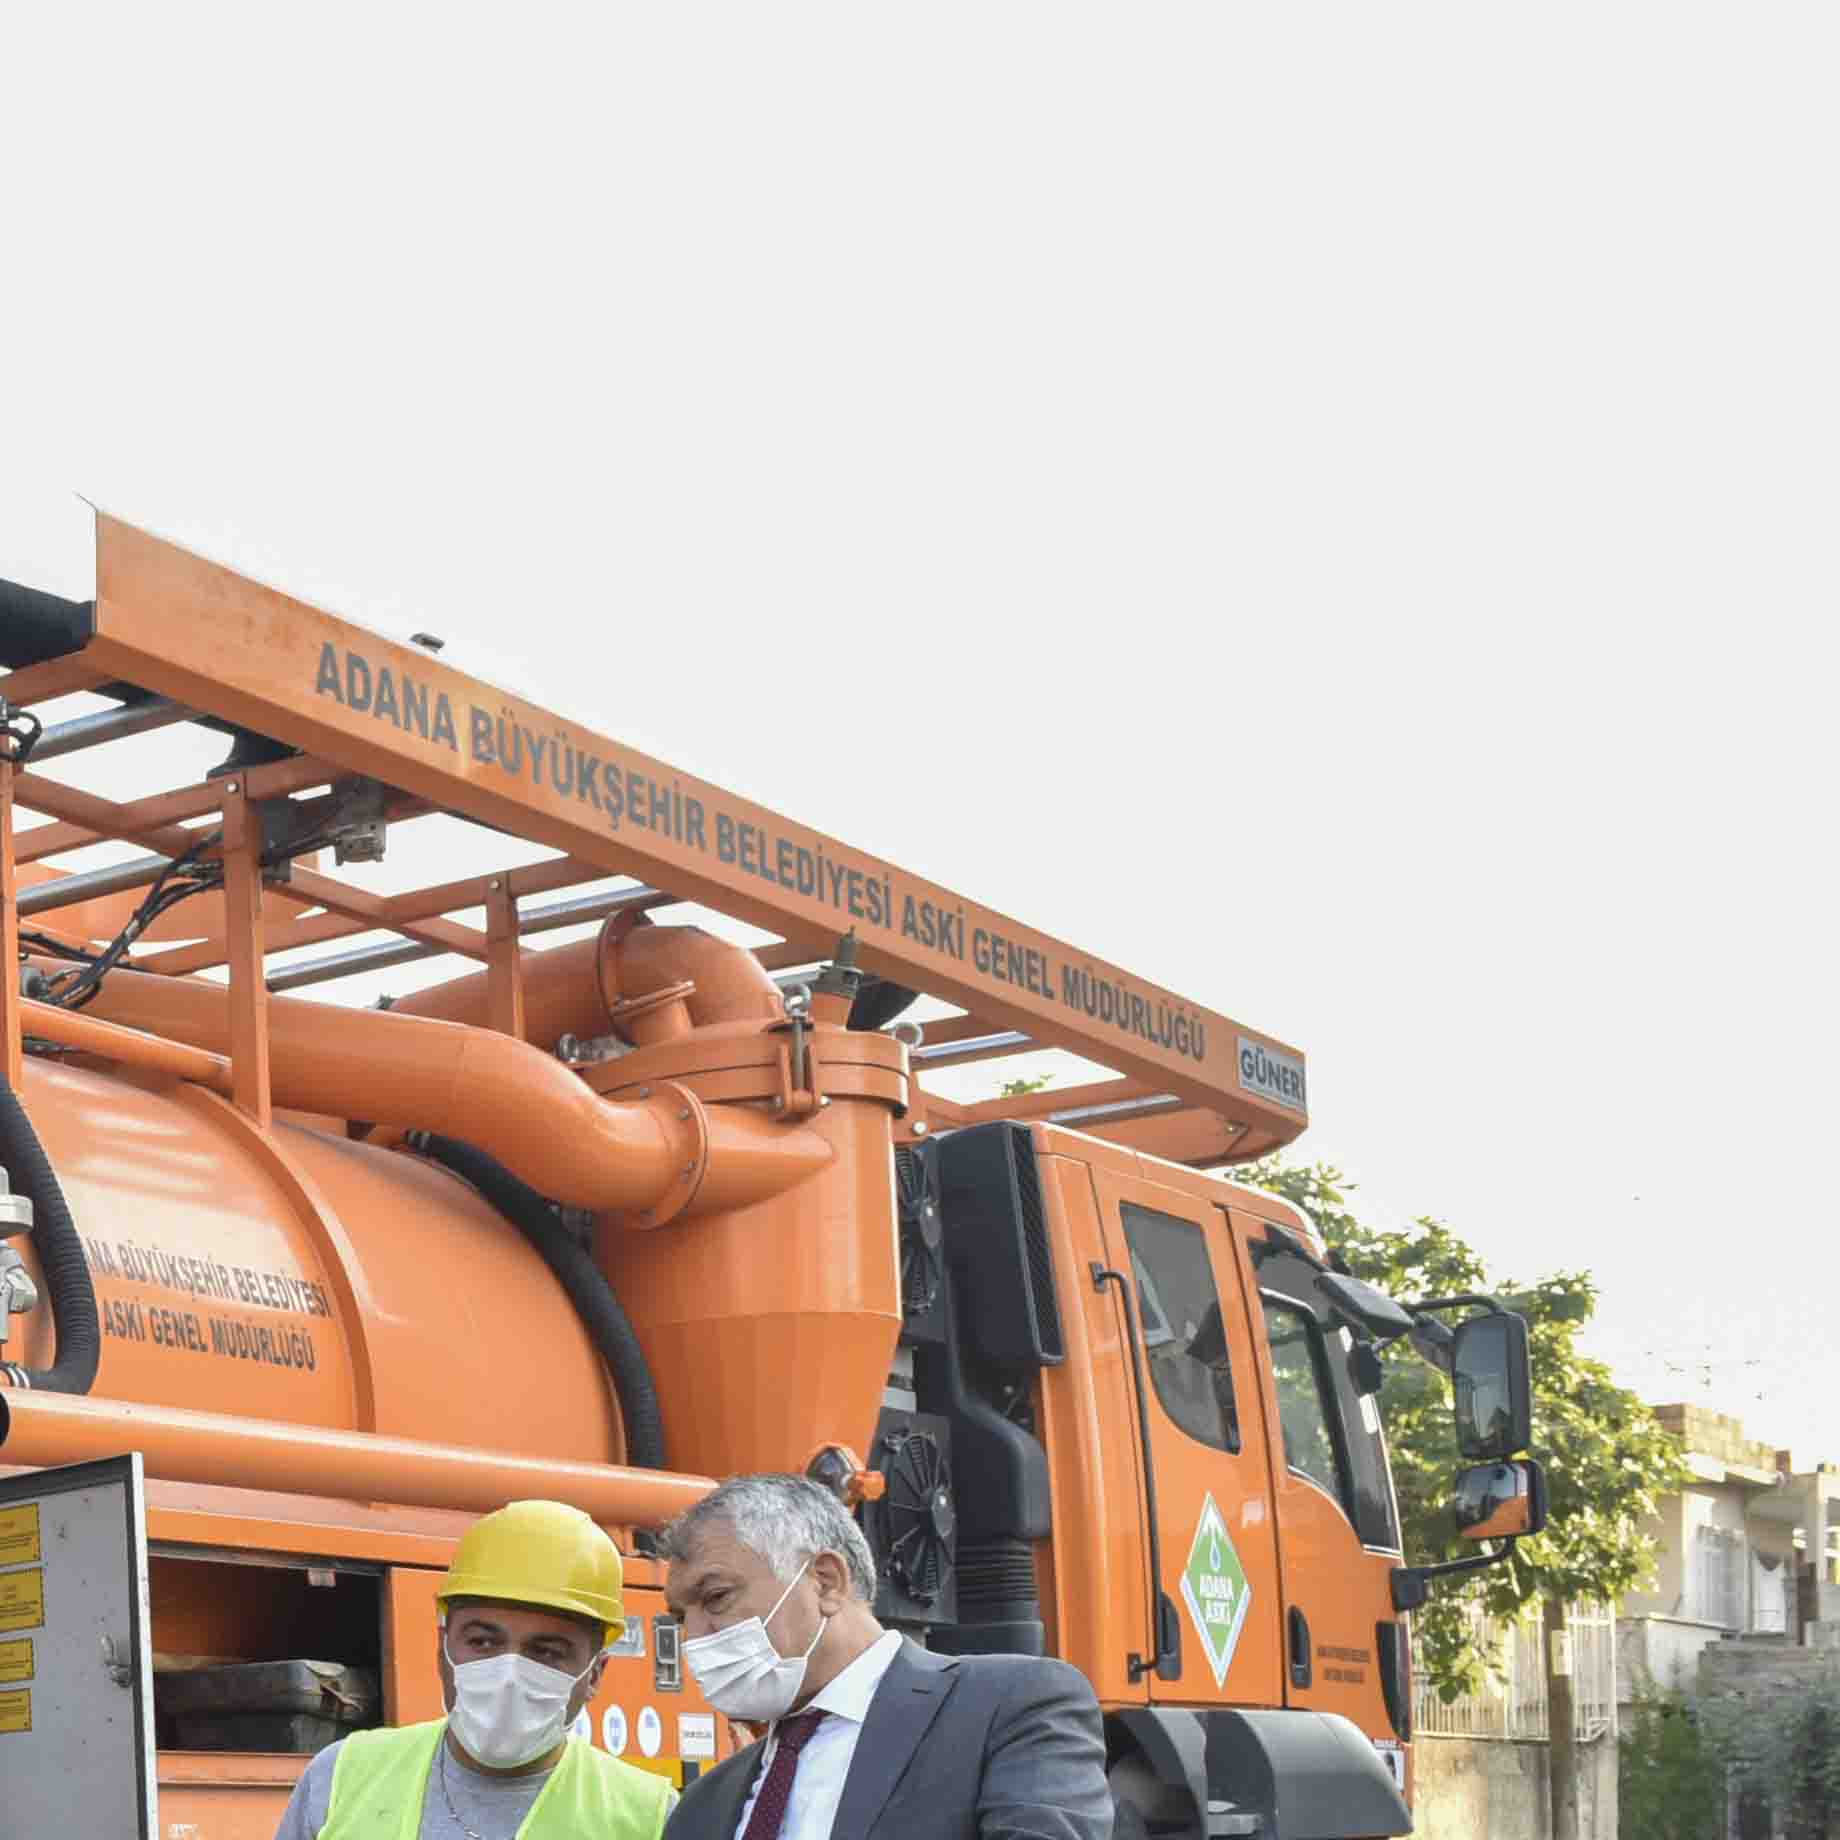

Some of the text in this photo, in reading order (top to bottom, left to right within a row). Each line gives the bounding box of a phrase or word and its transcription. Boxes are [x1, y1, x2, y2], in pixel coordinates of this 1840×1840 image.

[316, 641, 1207, 1062] ADANA BÜYÜKŞEHİR BELEDİYESİ ASKİ GENEL MÜDÜRLÜĞÜ
[103, 1298, 145, 1341] ASKİ
[149, 1307, 208, 1352] GENEL
